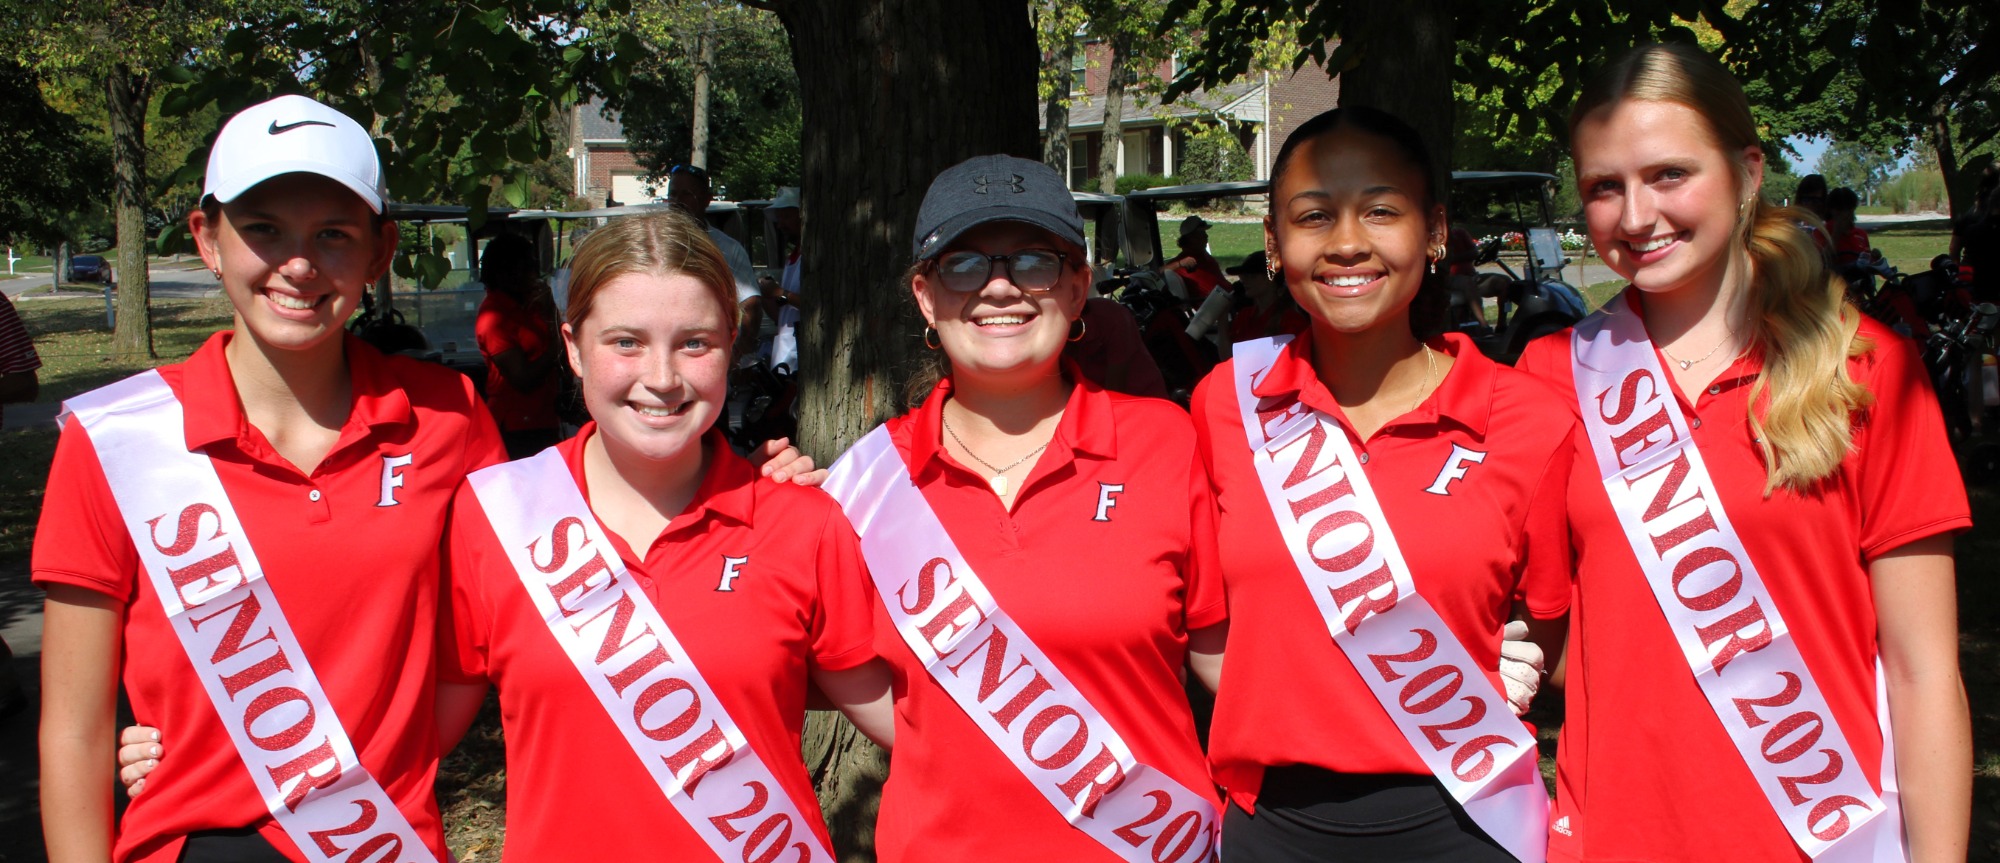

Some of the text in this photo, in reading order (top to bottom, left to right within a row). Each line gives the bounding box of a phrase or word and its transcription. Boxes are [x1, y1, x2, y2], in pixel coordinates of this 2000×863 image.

[373, 453, 412, 508] F
[714, 554, 748, 593] F
[1090, 481, 1125, 522] F
[1250, 366, 1518, 784] ENIOR 2026
[1424, 442, 1488, 497] F
[145, 502, 403, 863] SENIOR 20
[525, 516, 735, 801] SENIOR
[896, 557, 1126, 819] SENIOR
[1594, 368, 1873, 842] SENIOR 2026
